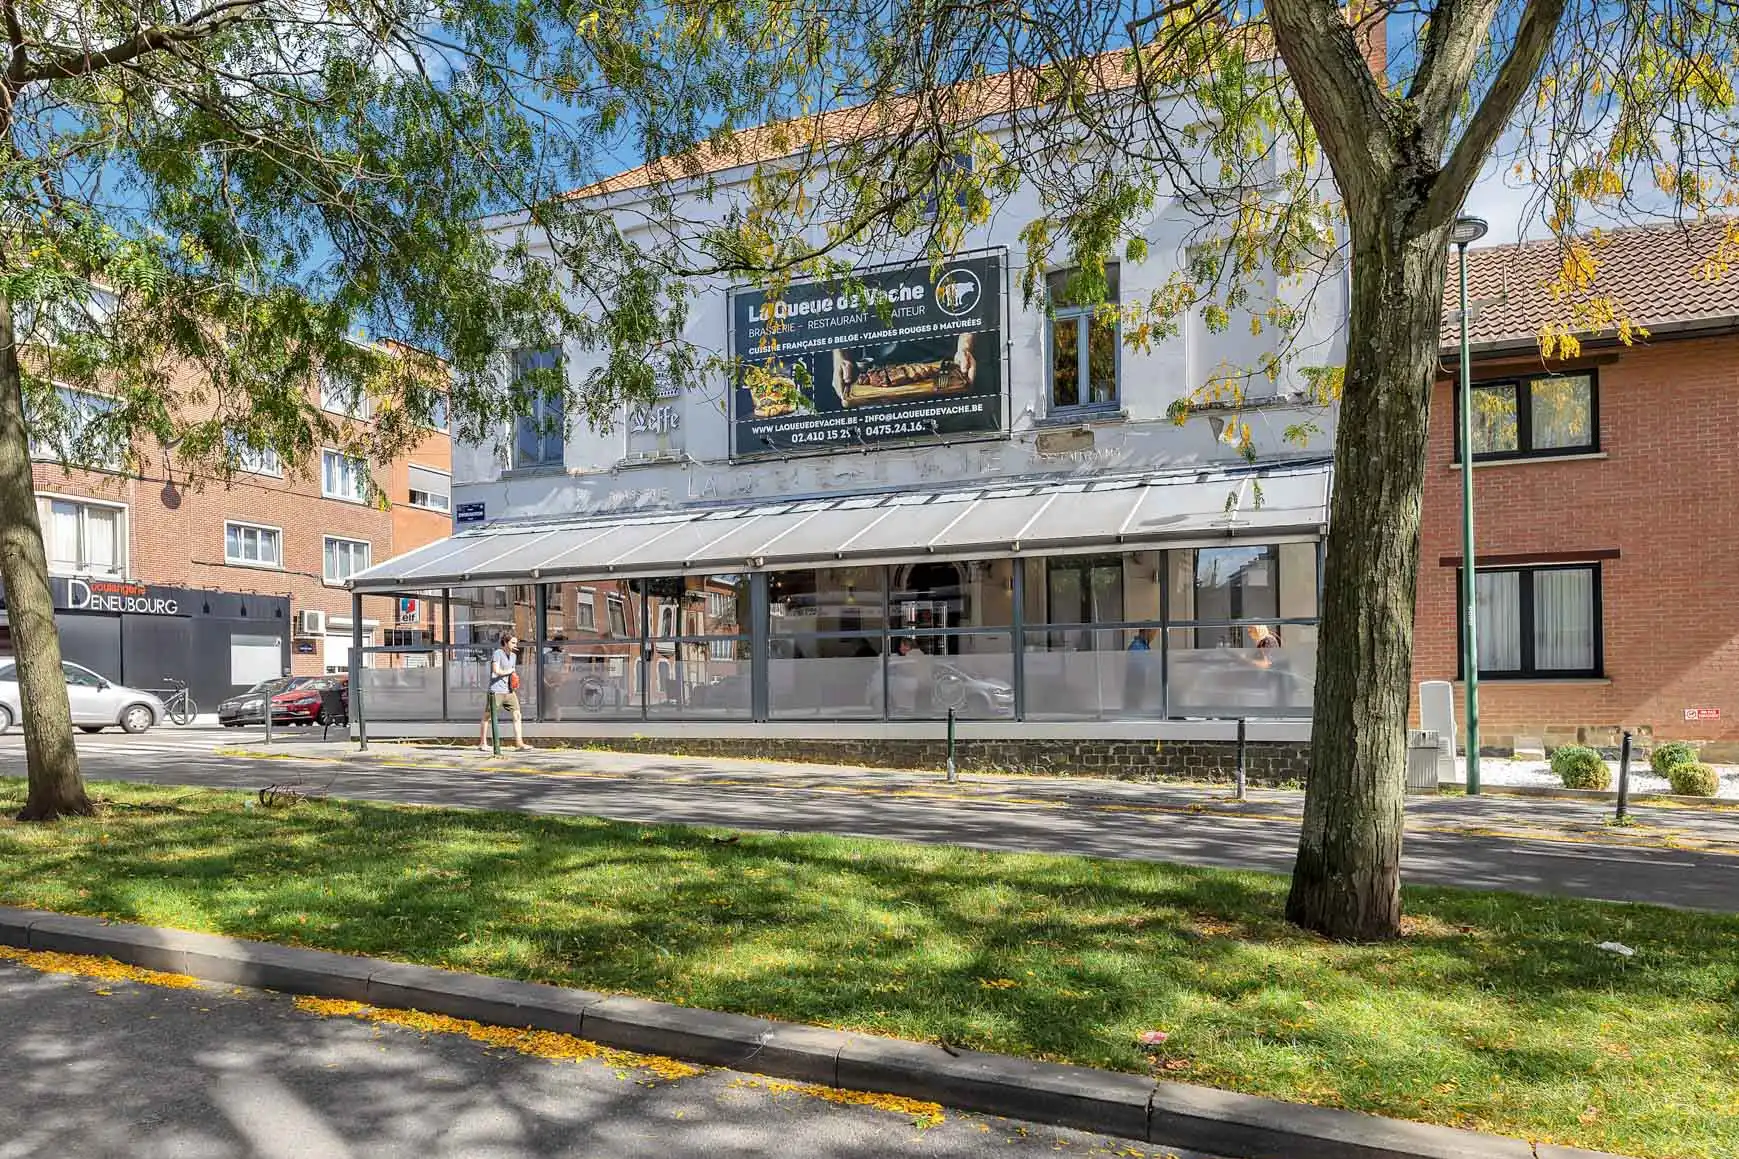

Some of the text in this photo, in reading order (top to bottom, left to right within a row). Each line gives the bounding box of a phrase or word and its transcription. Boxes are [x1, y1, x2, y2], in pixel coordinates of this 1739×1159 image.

[773, 297, 833, 320] Queue
[807, 312, 869, 330] RESTAURANT
[884, 304, 926, 319] AITEUR
[782, 337, 826, 353] FRANÇAISE
[834, 333, 859, 344] BELGE
[863, 328, 898, 340] VIANDES
[898, 324, 932, 336] ROUGES
[939, 317, 982, 330] MATURÉES
[864, 403, 983, 423] INFO@LAQUEUEDEVACHE.BE
[791, 431, 825, 443] 02.410
[827, 429, 838, 440] 15
[68, 578, 178, 615] DENEUBOURG
[402, 613, 416, 622] elf
